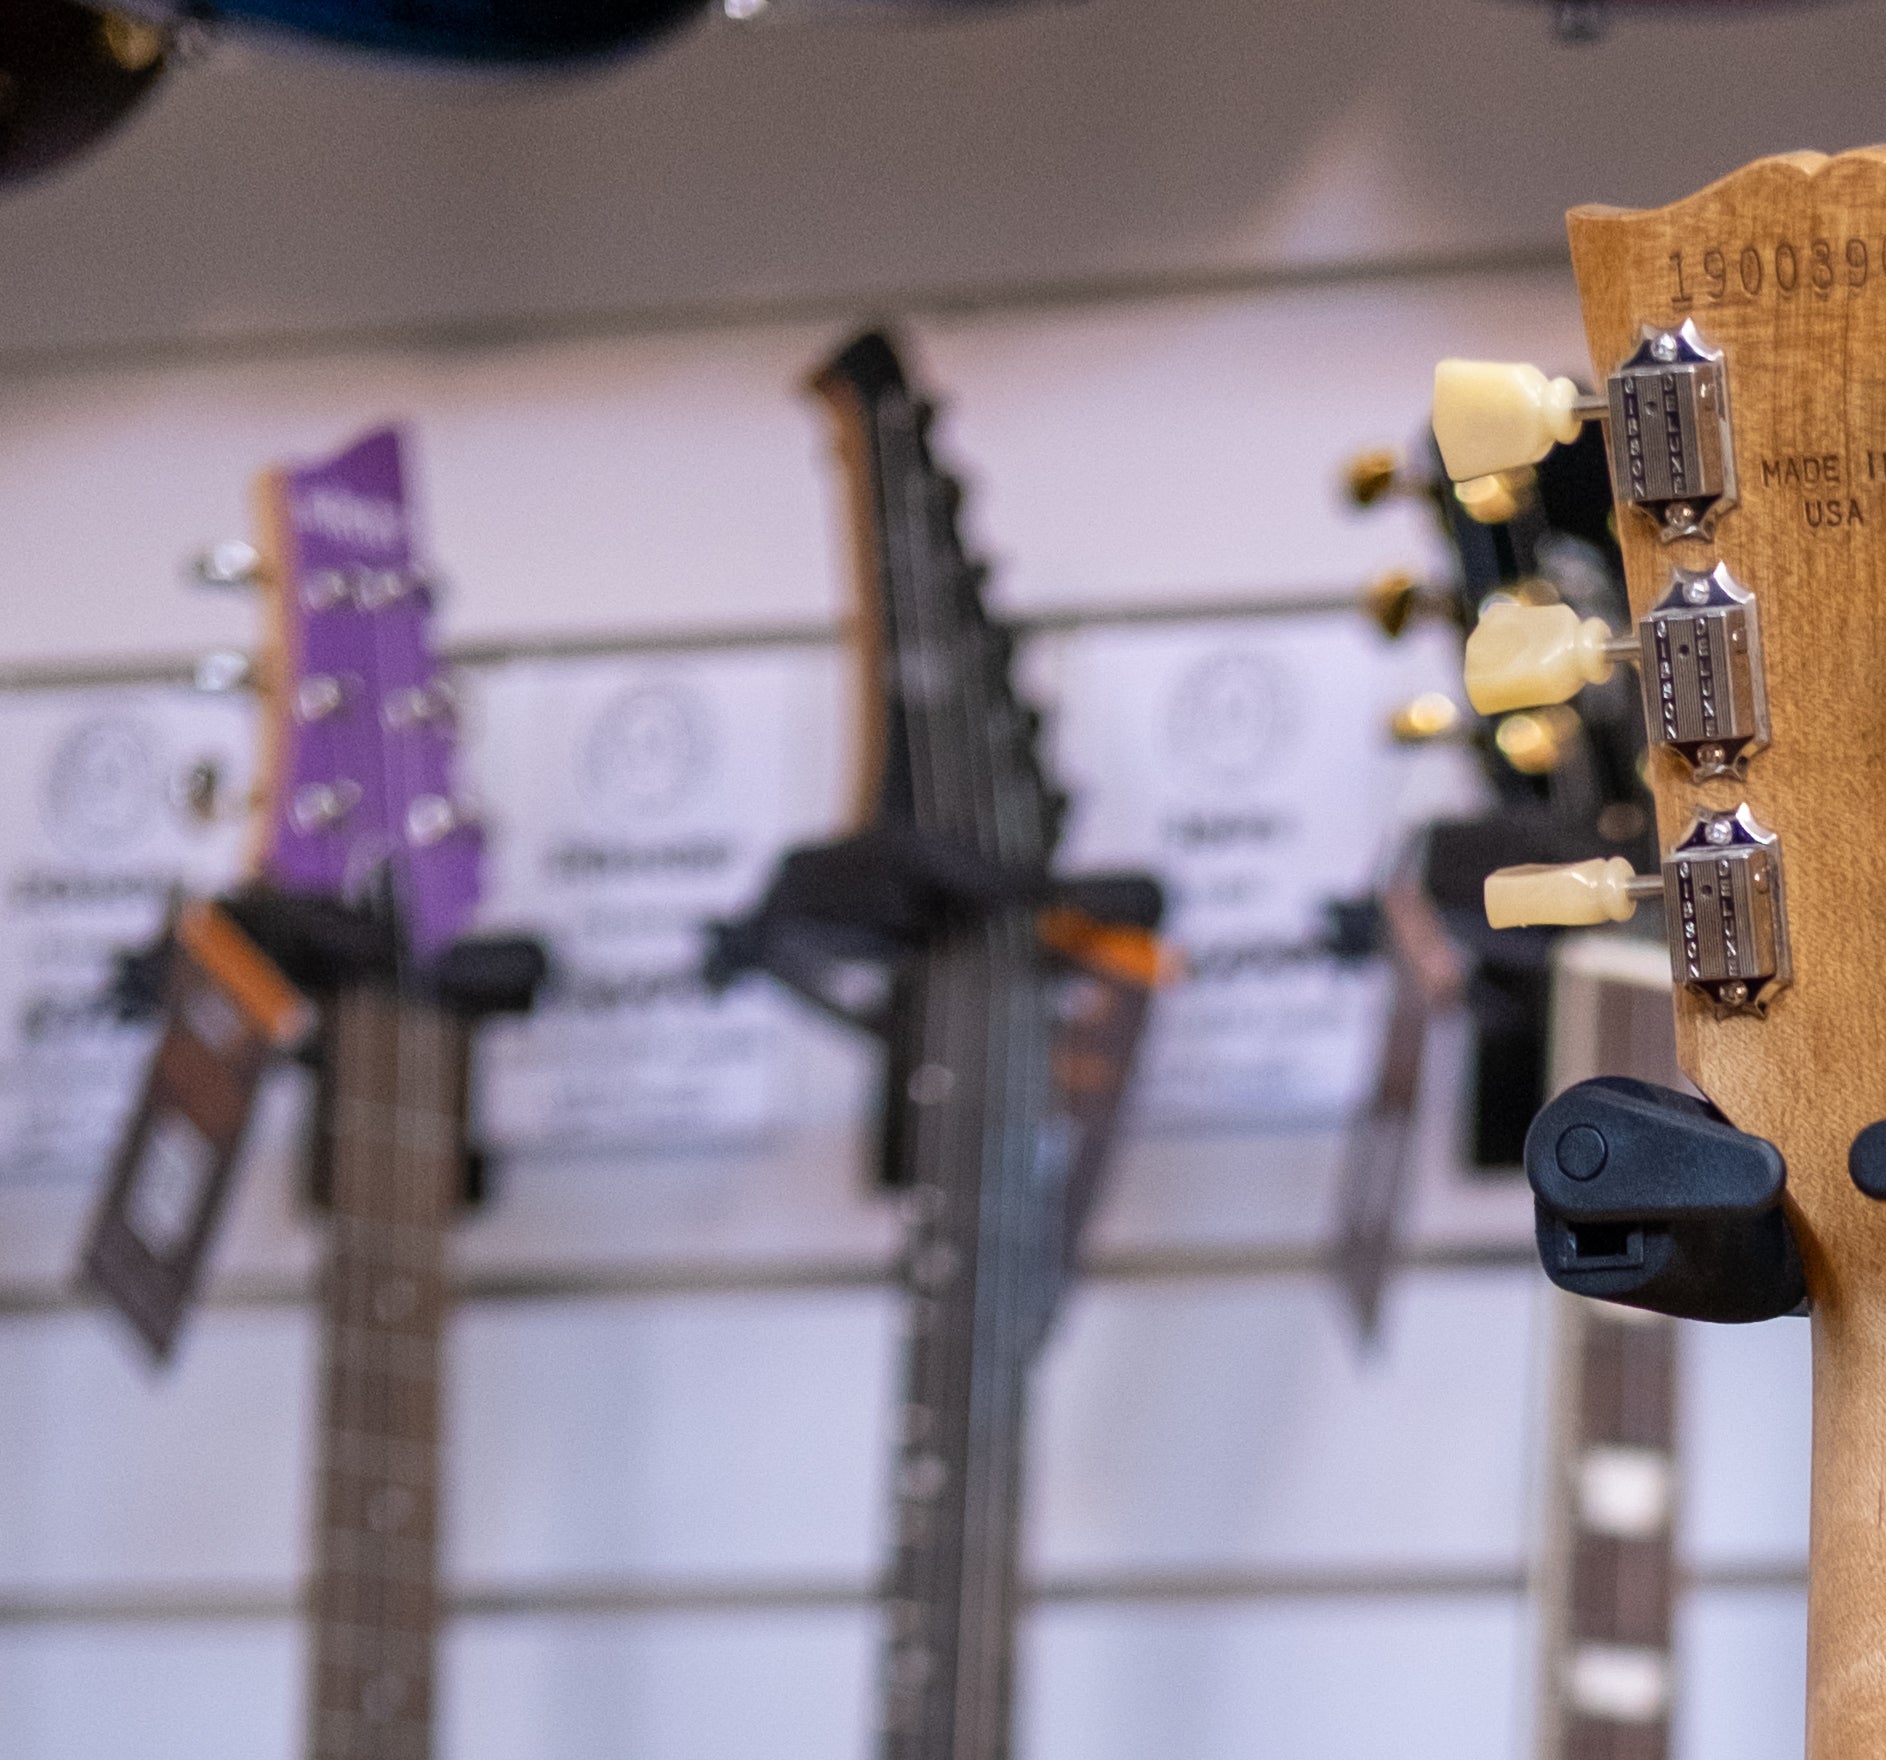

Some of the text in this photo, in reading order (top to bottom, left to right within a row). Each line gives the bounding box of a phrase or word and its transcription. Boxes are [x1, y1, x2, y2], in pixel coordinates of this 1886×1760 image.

[1623, 376, 1645, 498] GIBSON
[1761, 454, 1841, 487] MADE
[1804, 498, 1864, 528] USA
[1656, 620, 1677, 739] GIBSON
[1695, 618, 1717, 737] DELUXE
[1679, 861, 1700, 978] GIBSON
